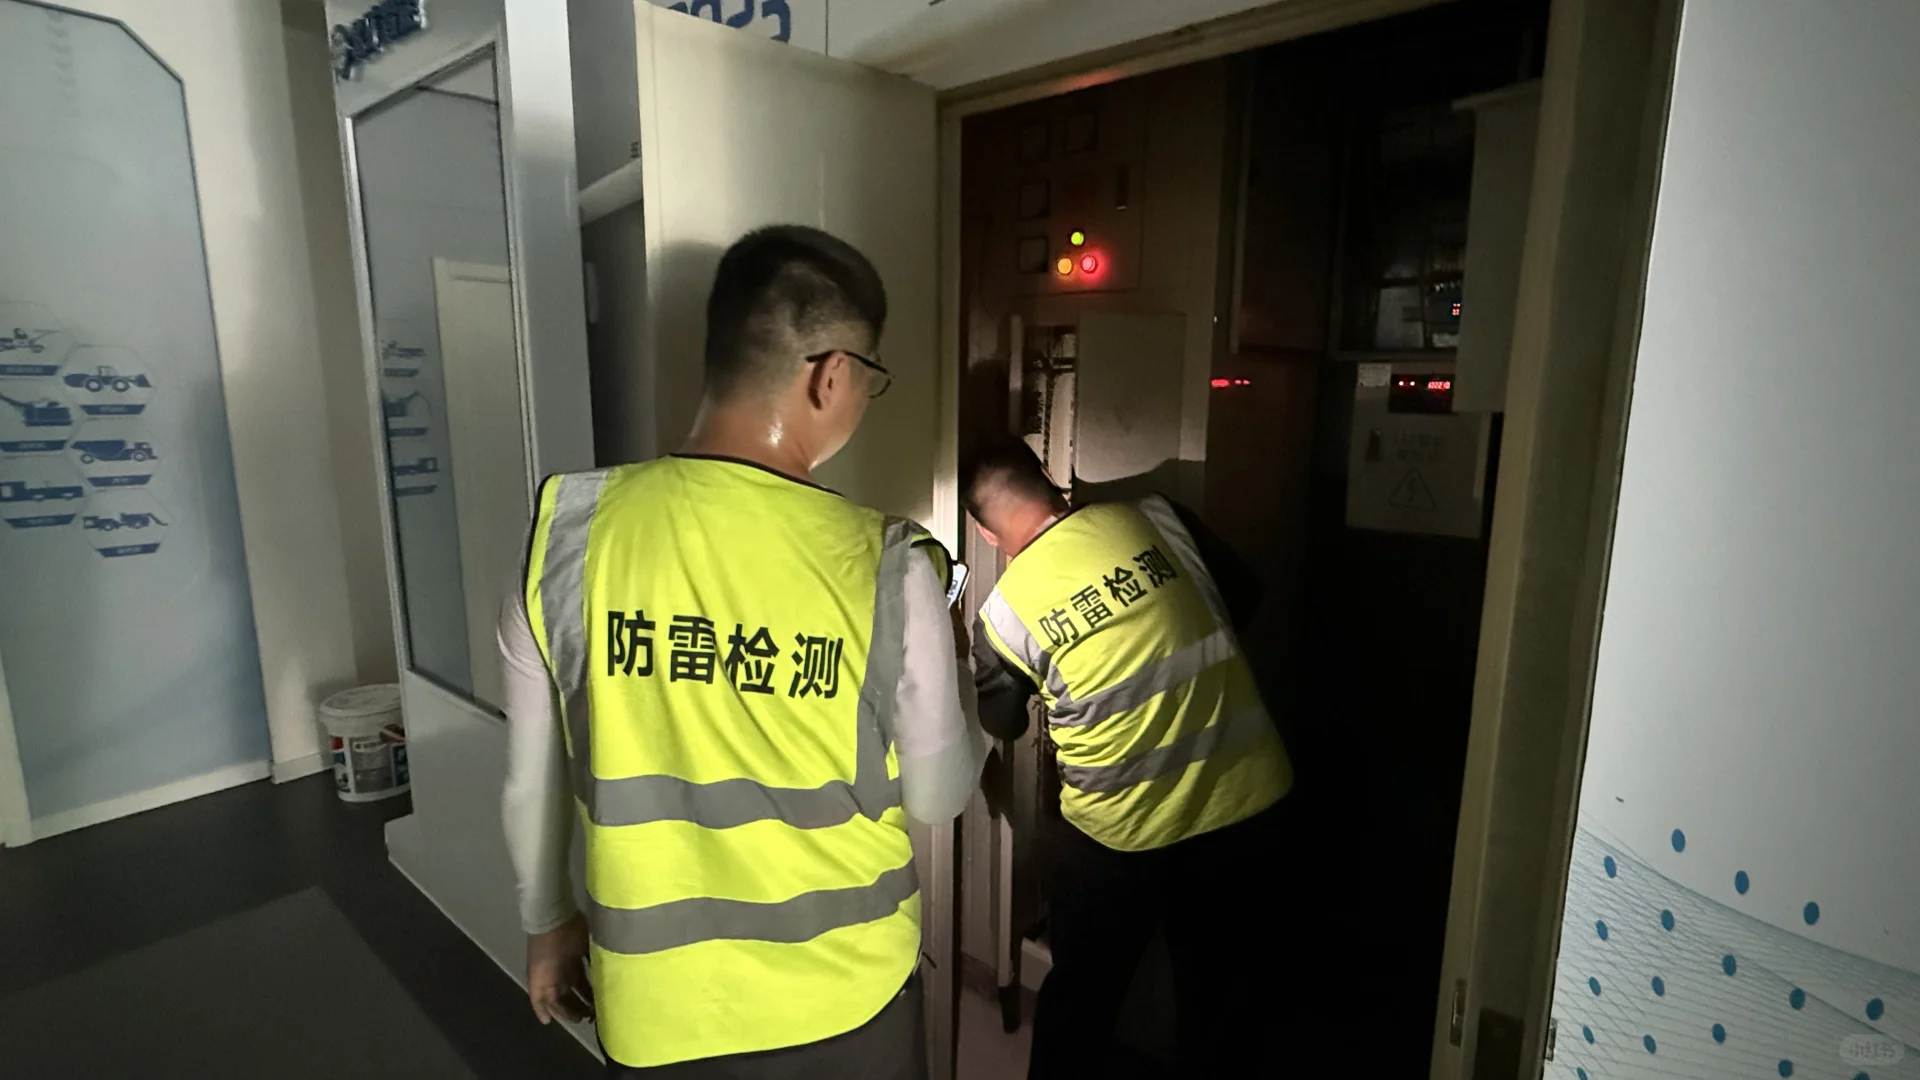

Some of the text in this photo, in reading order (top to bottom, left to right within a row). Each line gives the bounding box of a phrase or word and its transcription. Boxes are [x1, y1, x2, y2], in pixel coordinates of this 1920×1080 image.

[1038, 545, 1177, 647] 防雷检测
[607, 609, 844, 699] 防雷检测
